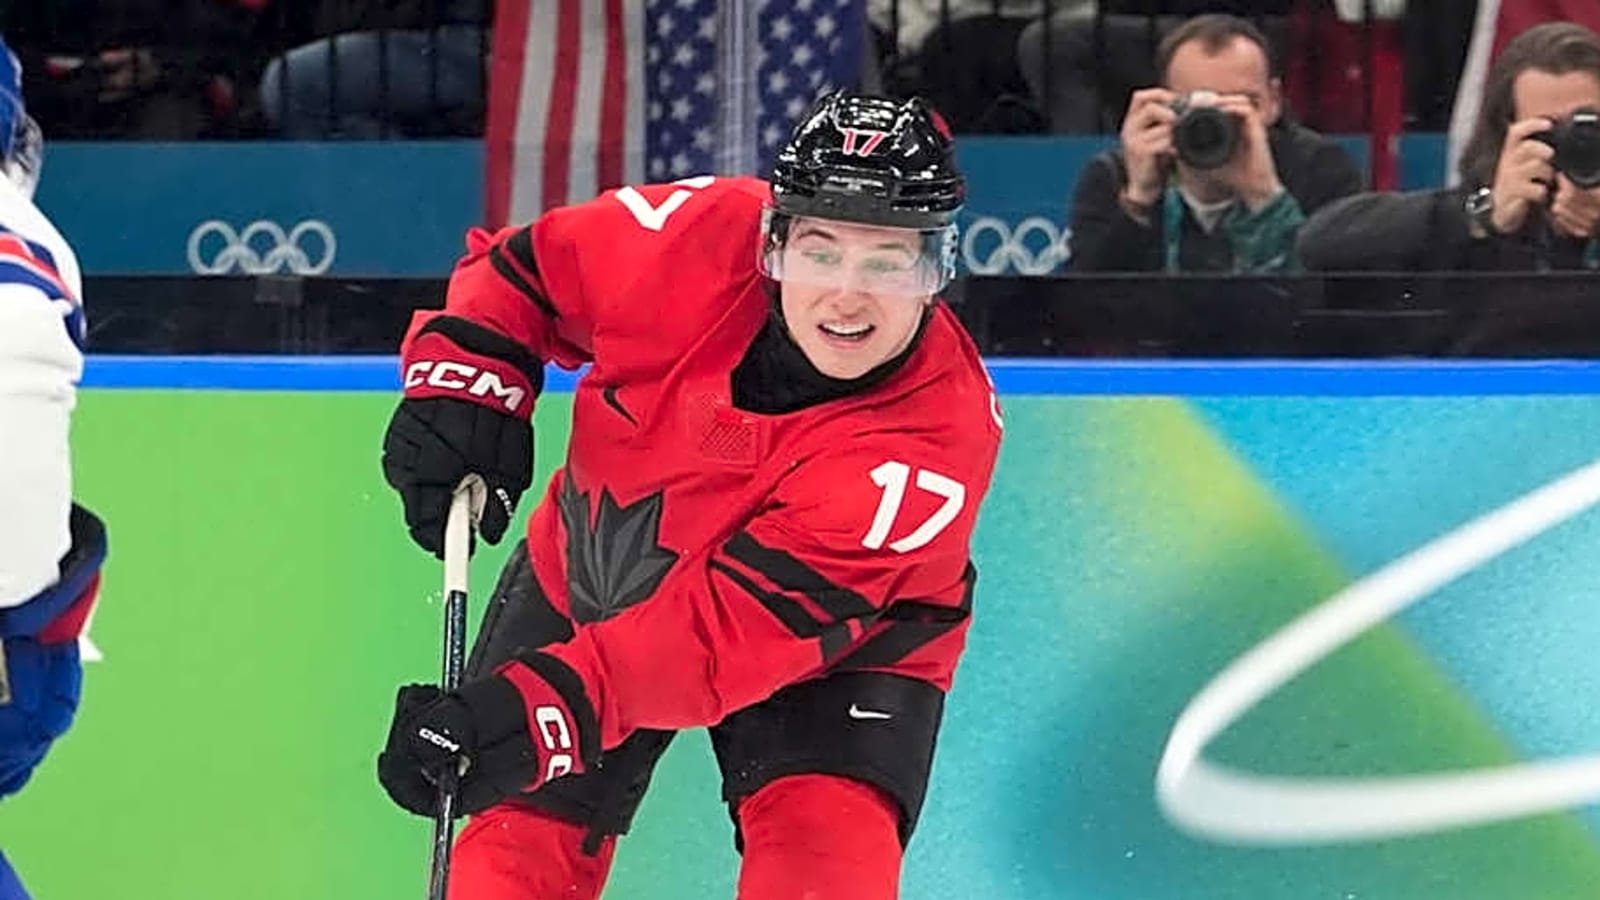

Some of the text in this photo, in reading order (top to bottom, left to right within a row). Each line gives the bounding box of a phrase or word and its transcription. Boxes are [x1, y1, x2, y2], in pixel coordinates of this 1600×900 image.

[842, 127, 886, 157] 17
[614, 175, 717, 232] 7
[404, 360, 525, 411] CCM
[860, 460, 966, 554] 17
[419, 727, 460, 752] CCM
